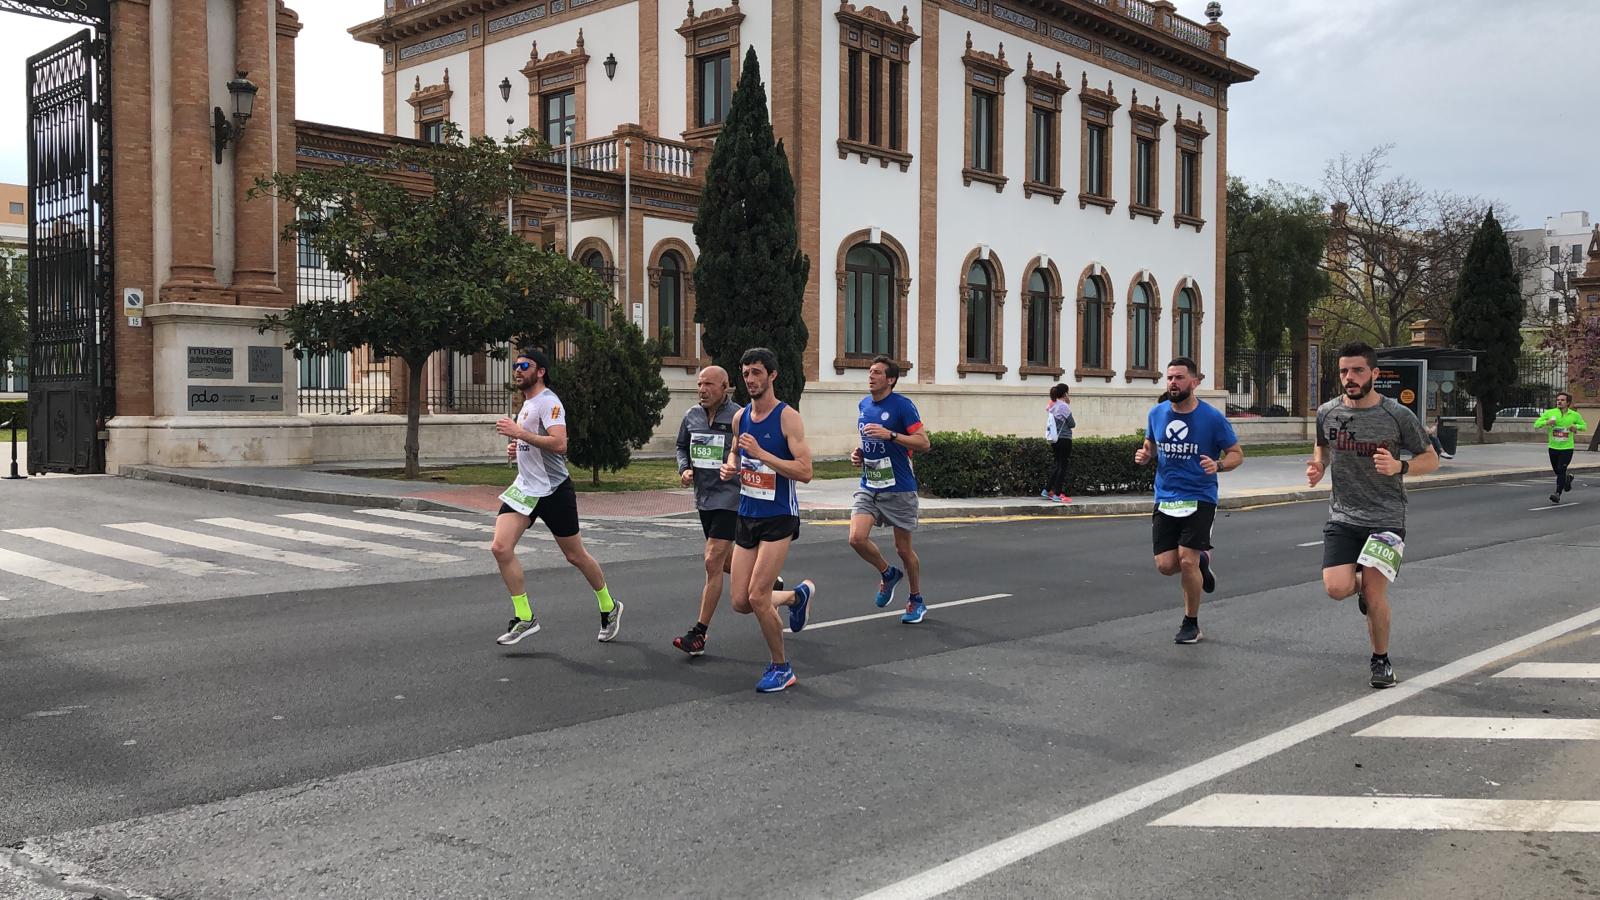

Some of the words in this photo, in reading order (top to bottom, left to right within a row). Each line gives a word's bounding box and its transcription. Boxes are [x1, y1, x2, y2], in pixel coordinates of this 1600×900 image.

[132, 317, 139, 326] 15
[190, 348, 232, 356] museo
[692, 446, 712, 456] 1583
[742, 471, 762, 484] 4619
[1368, 542, 1395, 560] 2100
